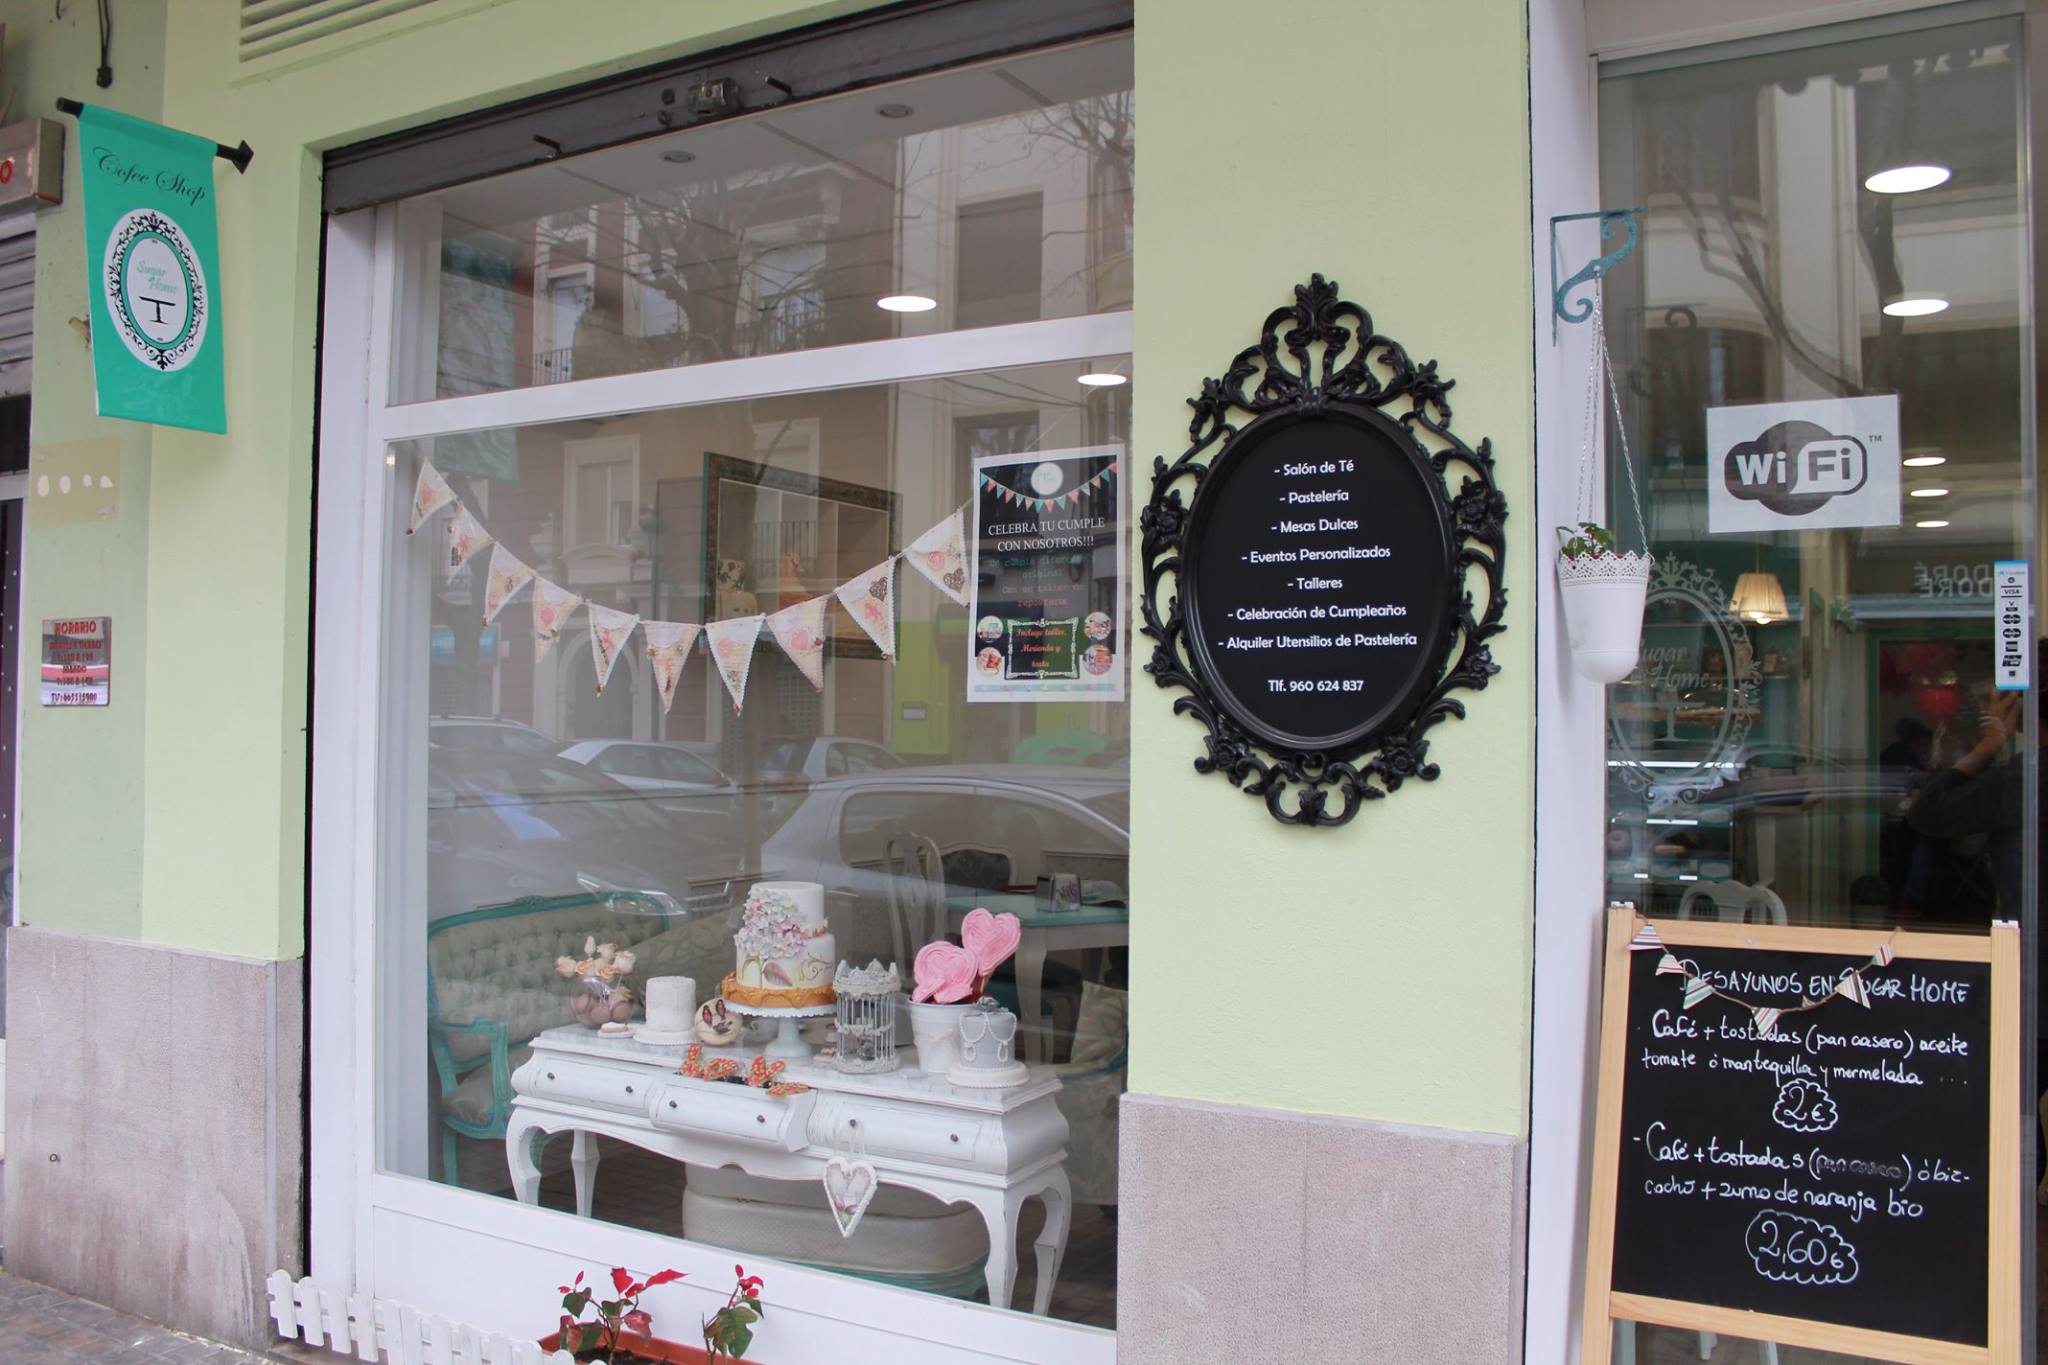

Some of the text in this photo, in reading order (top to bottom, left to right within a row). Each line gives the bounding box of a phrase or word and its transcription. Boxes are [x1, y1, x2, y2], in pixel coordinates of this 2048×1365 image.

[92, 146, 206, 206] Cofee Shop
[1283, 463, 1317, 476] Salón
[1319, 461, 1336, 473] de
[1338, 459, 1355, 472] Té
[1288, 489, 1350, 504] Pastelería
[988, 517, 1106, 536] CELEBRA TU CUMPLE
[1280, 520, 1316, 533] Mesas
[1319, 518, 1359, 531] Dulces
[997, 535, 1095, 552] CON NOSOTROS!!!
[1250, 550, 1297, 563] Eventos
[1299, 545, 1391, 561] Personalizados
[1297, 577, 1343, 590] Talleres
[1236, 607, 1307, 621] Celebración
[1310, 606, 1326, 619] de
[1328, 604, 1407, 619] Cumpleaños
[1226, 637, 1274, 651] Alquiler
[1276, 635, 1333, 648] Utensilios
[1335, 634, 1351, 647] de
[1354, 633, 1418, 646] Pastelería
[1640, 645, 1687, 668] ugar
[1268, 679, 1364, 692] Tlf. 960 624 837
[1649, 664, 1712, 690] Home
[1808, 975, 1832, 997] EN
[1910, 973, 1970, 1004] HOME
[1652, 1008, 1698, 1038] Café
[1919, 1032, 1969, 1056] aceite
[1641, 1047, 1696, 1069] tomate
[1722, 1047, 1818, 1087] mantequilla
[1819, 1065, 1829, 1087] y
[1833, 1058, 1924, 1086] mermelada
[1646, 1121, 1690, 1161] Café
[1719, 1182, 1771, 1200] zumo
[1774, 1178, 1799, 1203] de
[1804, 1190, 1877, 1223] naranja
[1887, 1188, 1924, 1217] bio
